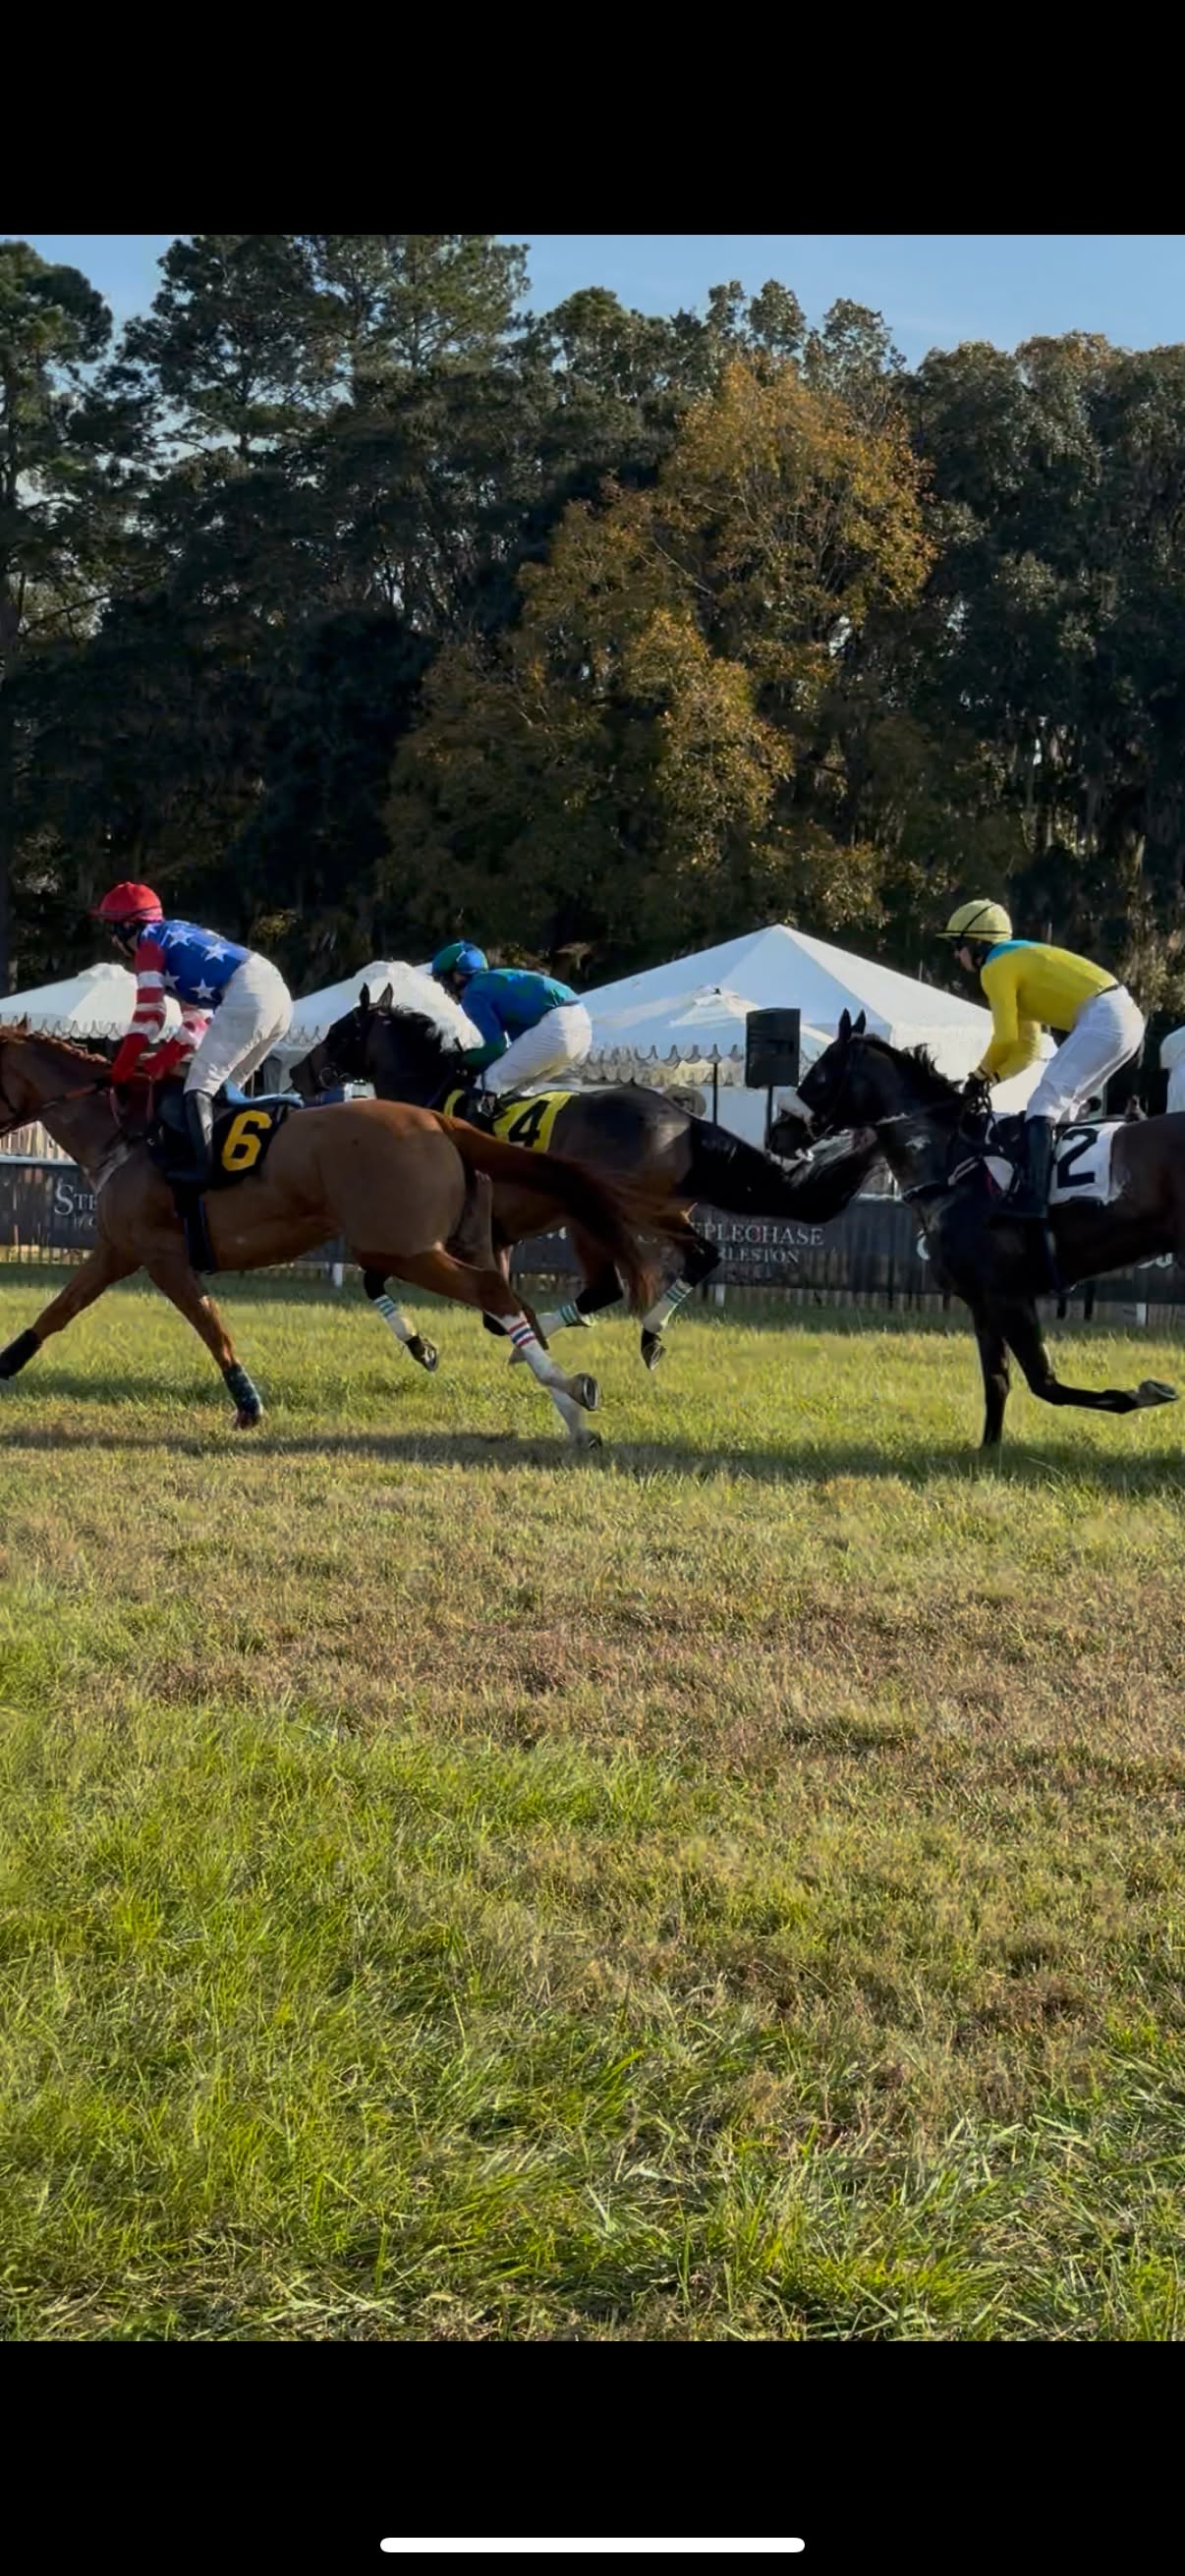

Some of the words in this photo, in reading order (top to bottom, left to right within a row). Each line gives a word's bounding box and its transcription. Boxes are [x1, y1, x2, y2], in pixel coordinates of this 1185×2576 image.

[221, 1109, 272, 1172] 6
[508, 1099, 550, 1148] 4
[1057, 1128, 1100, 1189] 2
